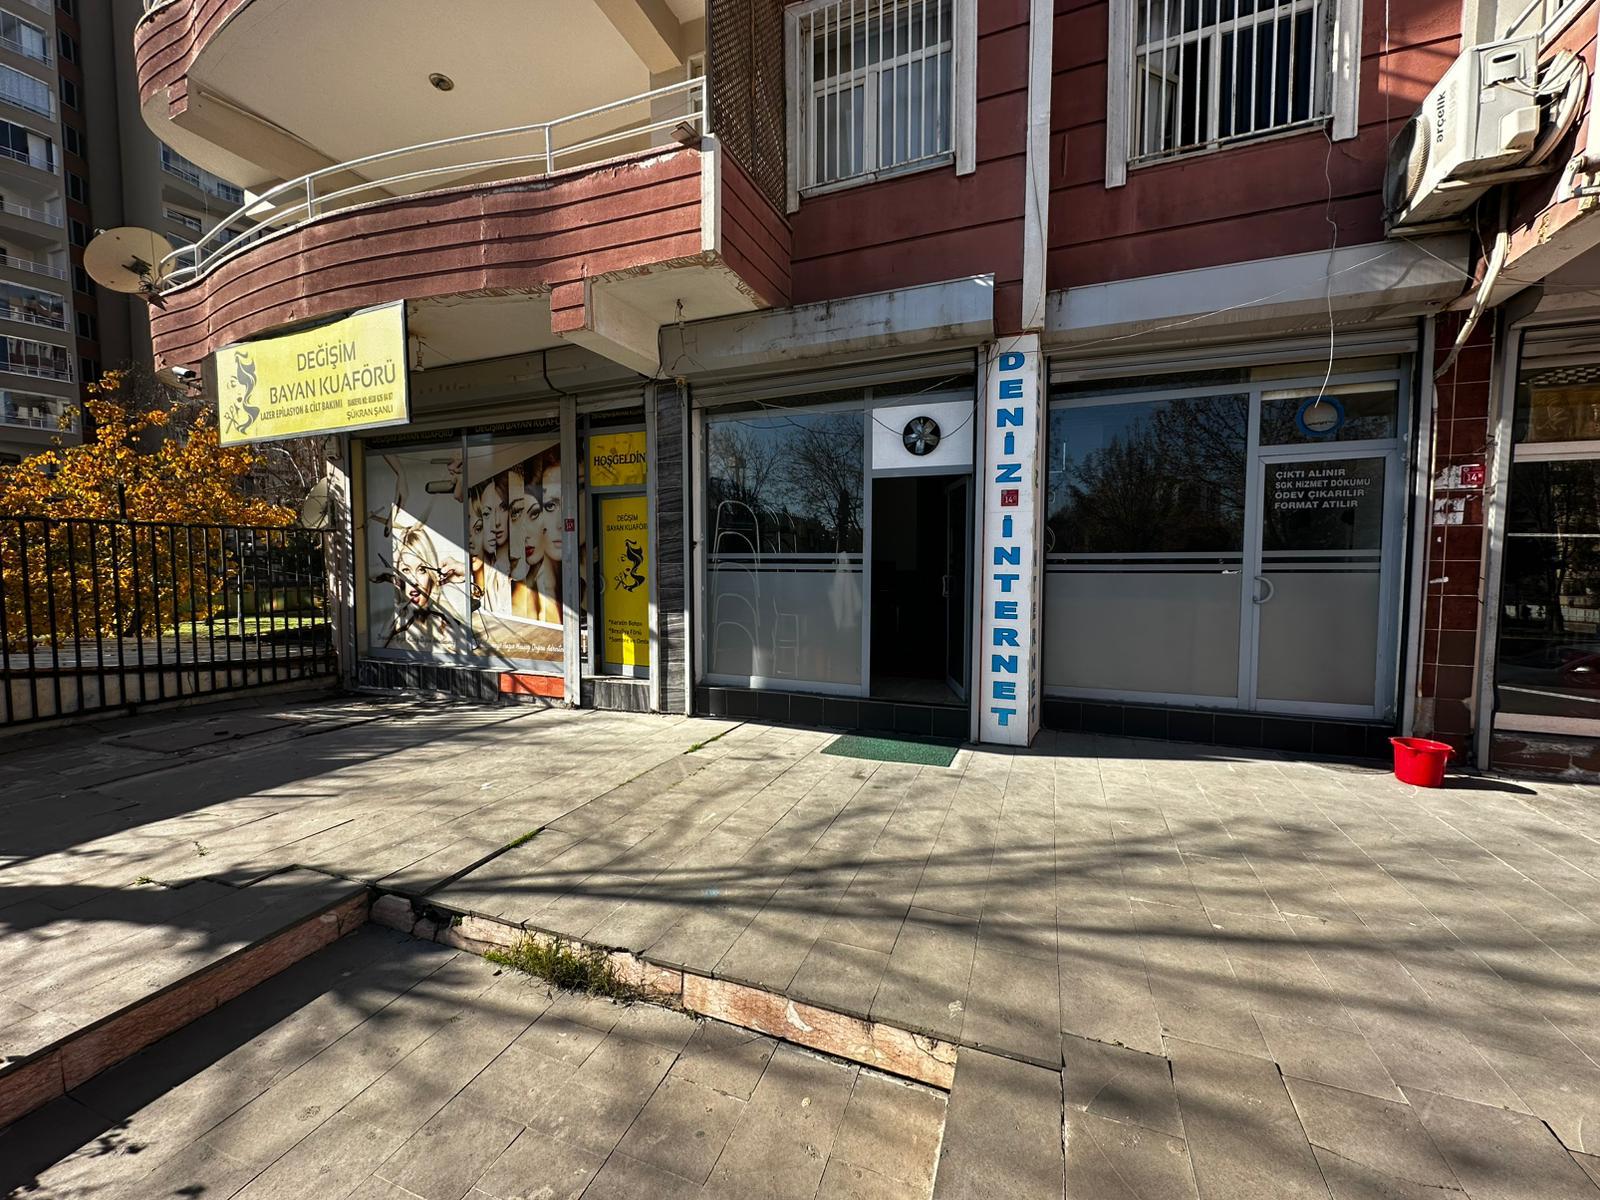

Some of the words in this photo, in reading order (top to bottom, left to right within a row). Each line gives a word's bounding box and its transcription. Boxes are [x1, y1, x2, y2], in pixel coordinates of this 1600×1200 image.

[1436, 90, 1448, 144] arçelik
[297, 340, 356, 372] DEĞİŞİM
[269, 378, 316, 405] BAYAN
[319, 359, 396, 396] KUAFÖRÜ
[260, 410, 277, 421] LAZER
[276, 405, 304, 419] EPİLASYON
[304, 406, 309, 414] &
[309, 401, 321, 413] CİLT
[322, 399, 343, 411] BAKIMI
[346, 407, 373, 420] ŞÜKRAN
[373, 404, 394, 417] ŞANLI
[1275, 470, 1305, 480] ÇIKTI
[1308, 468, 1346, 477] ALINIR
[1275, 481, 1293, 489] SGK
[1274, 490, 1305, 499] ÖDEV
[1308, 488, 1365, 500] ÇIKARILIR
[1274, 501, 1319, 510] FORMAT
[1322, 499, 1358, 509] ATILIR
